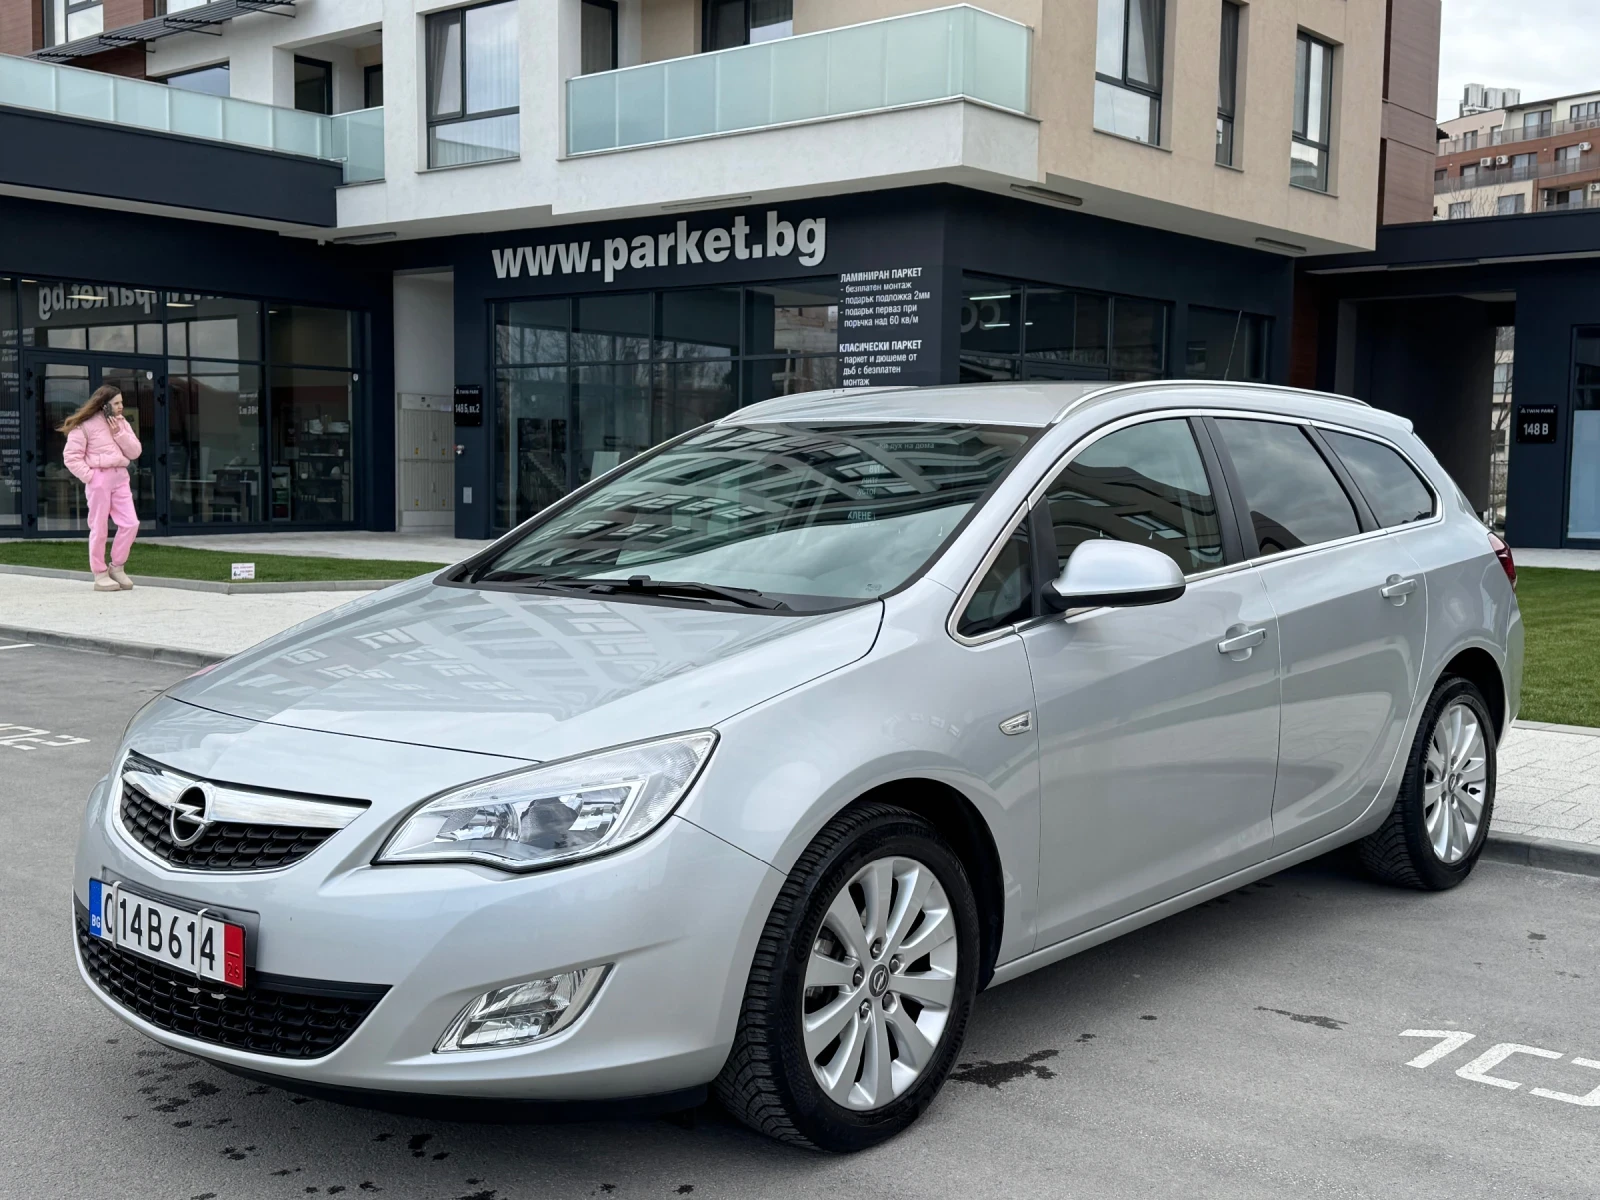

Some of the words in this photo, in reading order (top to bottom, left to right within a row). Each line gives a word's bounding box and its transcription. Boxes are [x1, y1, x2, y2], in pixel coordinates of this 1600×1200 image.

[492, 210, 826, 283] www.parket.bg
[840, 270, 890, 283] ЛАМИНИРАН
[891, 267, 922, 279] ПАРКЕТ
[845, 284, 882, 293] безплатен
[883, 281, 912, 291] монтаж
[845, 296, 874, 305] подарък
[875, 293, 912, 303] подложка
[914, 290, 931, 300] 2мм
[845, 307, 874, 317] подарък
[875, 305, 902, 315] перваз
[903, 304, 918, 314] при
[844, 318, 873, 328] поръчка
[874, 317, 888, 326] над
[889, 315, 899, 325] 60
[901, 314, 919, 325] кв/м
[839, 341, 890, 353] КЛАСИЧЕСКИ
[891, 339, 922, 350] ПАРКЕТ
[844, 355, 868, 365] паркет
[869, 355, 875, 363] и
[876, 353, 907, 364] дюшеме
[908, 353, 917, 361] от
[843, 365, 856, 376] дъб
[863, 365, 901, 375] безплатен
[843, 378, 870, 387] монтаж
[1523, 422, 1541, 436] 148
[91, 914, 101, 928] BG
